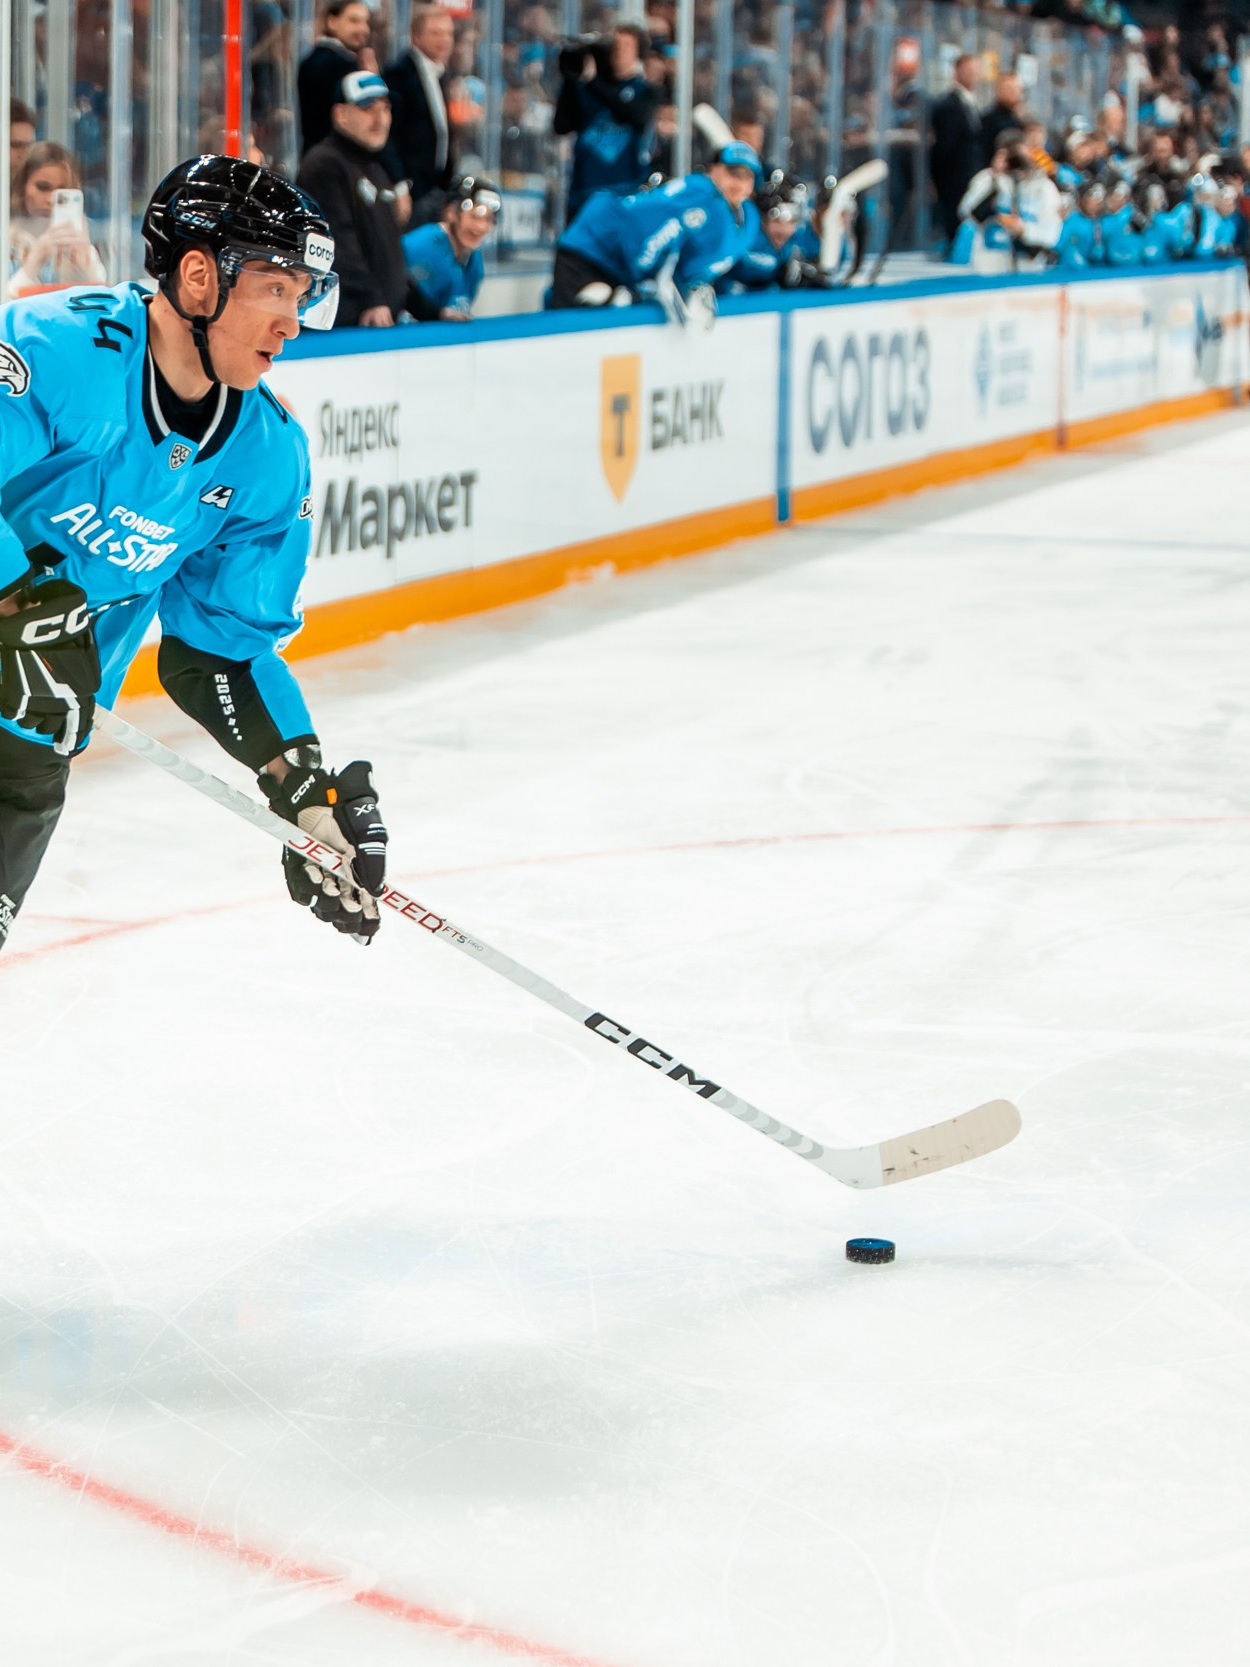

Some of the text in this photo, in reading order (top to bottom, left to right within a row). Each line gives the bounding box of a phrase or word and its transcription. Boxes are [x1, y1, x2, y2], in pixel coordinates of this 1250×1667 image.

[180, 212, 217, 229] CCM
[320, 401, 400, 462] Яндекс
[651, 378, 725, 451] БАНК
[108, 505, 176, 540] FONBET
[315, 470, 478, 559] Маркет
[21, 602, 90, 645] CC
[214, 673, 236, 716] 2025
[290, 774, 317, 804] CCM
[584, 1012, 722, 1099] CCM
